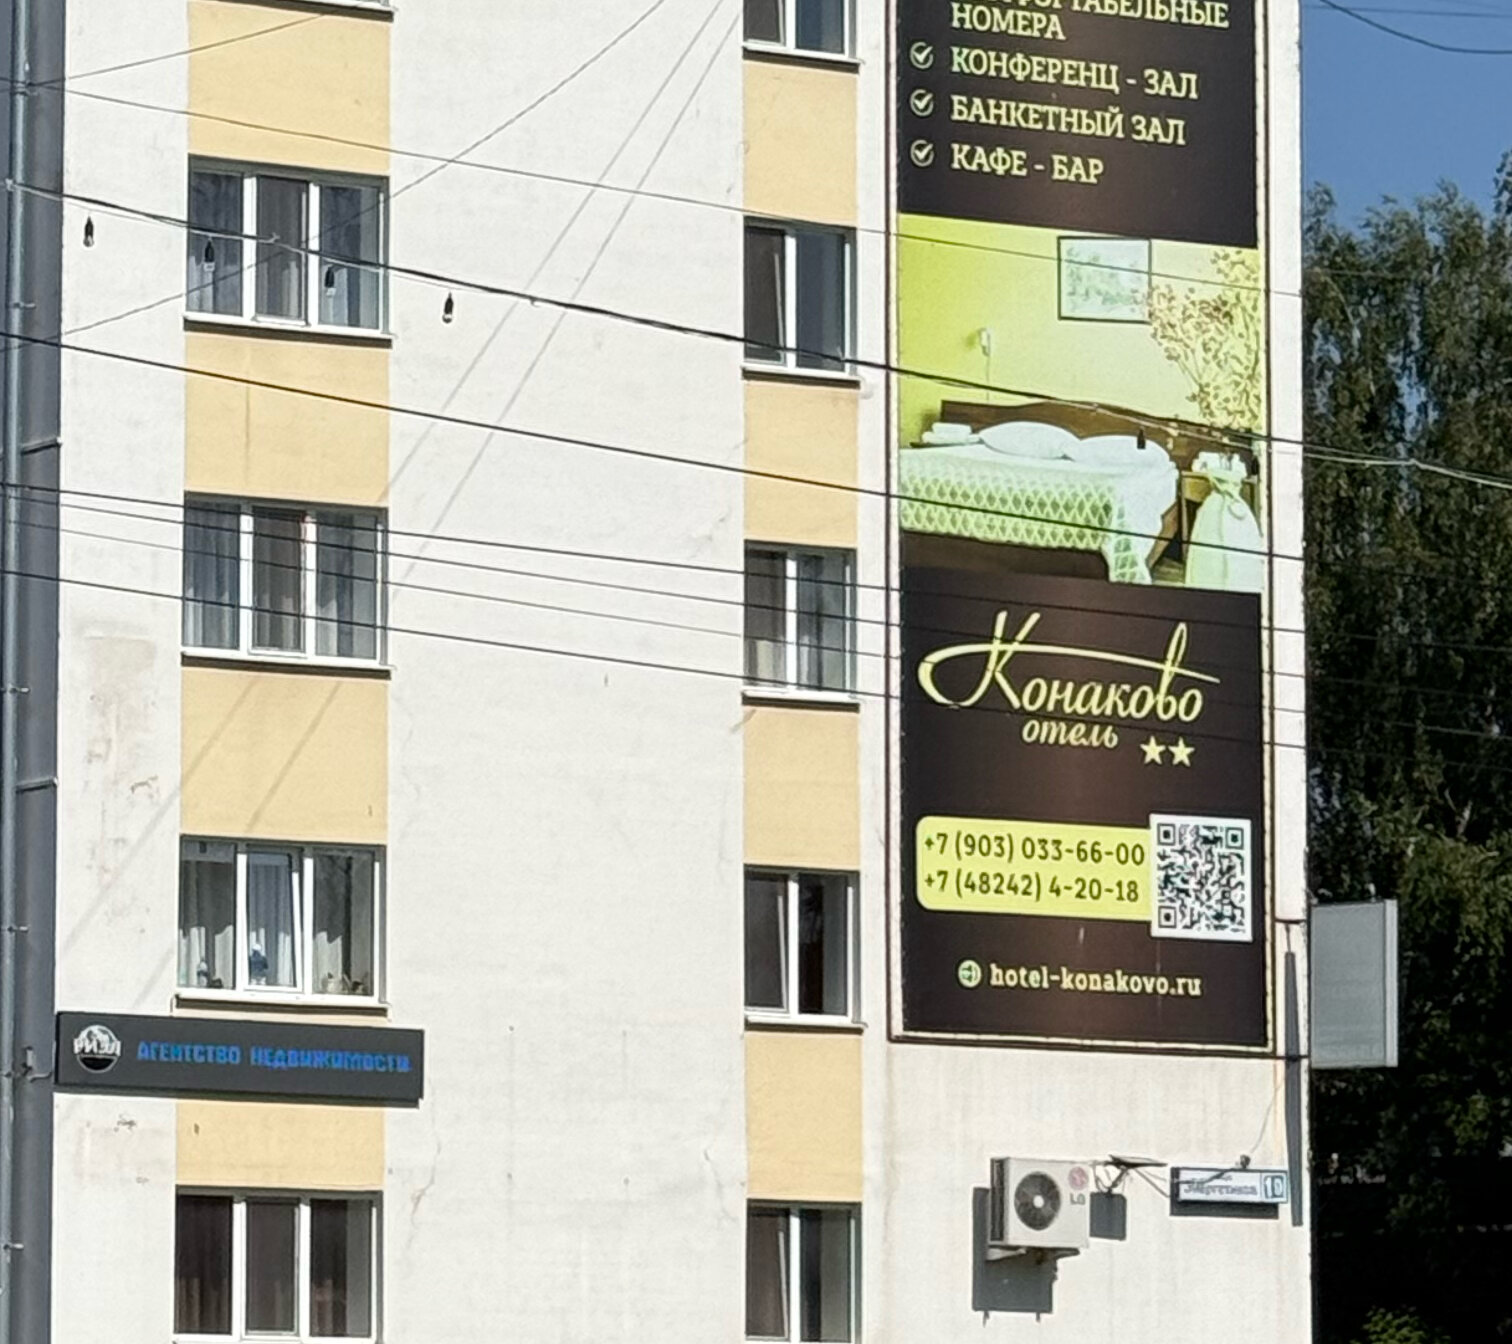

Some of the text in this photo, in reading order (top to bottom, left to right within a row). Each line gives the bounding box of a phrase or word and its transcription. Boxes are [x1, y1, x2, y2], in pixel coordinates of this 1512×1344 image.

[950, 5, 1067, 42] НОМЕРА
[949, 46, 1119, 95] КОНФЕРЕНЦ
[1144, 68, 1199, 100] ЗАЛ
[950, 94, 1186, 146] БАНКЕТНЫЙ ЗАЛ
[950, 142, 1028, 177] КАФЕ
[1051, 155, 1104, 185] БАР
[917, 610, 1221, 723] Конаково
[1022, 718, 1119, 750] отель
[924, 831, 1146, 867] +7 (903) 033-66-00
[924, 869, 1140, 903] +7 (48242) 4-20-18
[990, 961, 1202, 997] hotel-konakovo.ru
[137, 1041, 412, 1073] АГЕНТСТВО НЕДВИЖИМОСТИ
[1263, 1175, 1285, 1199] 10
